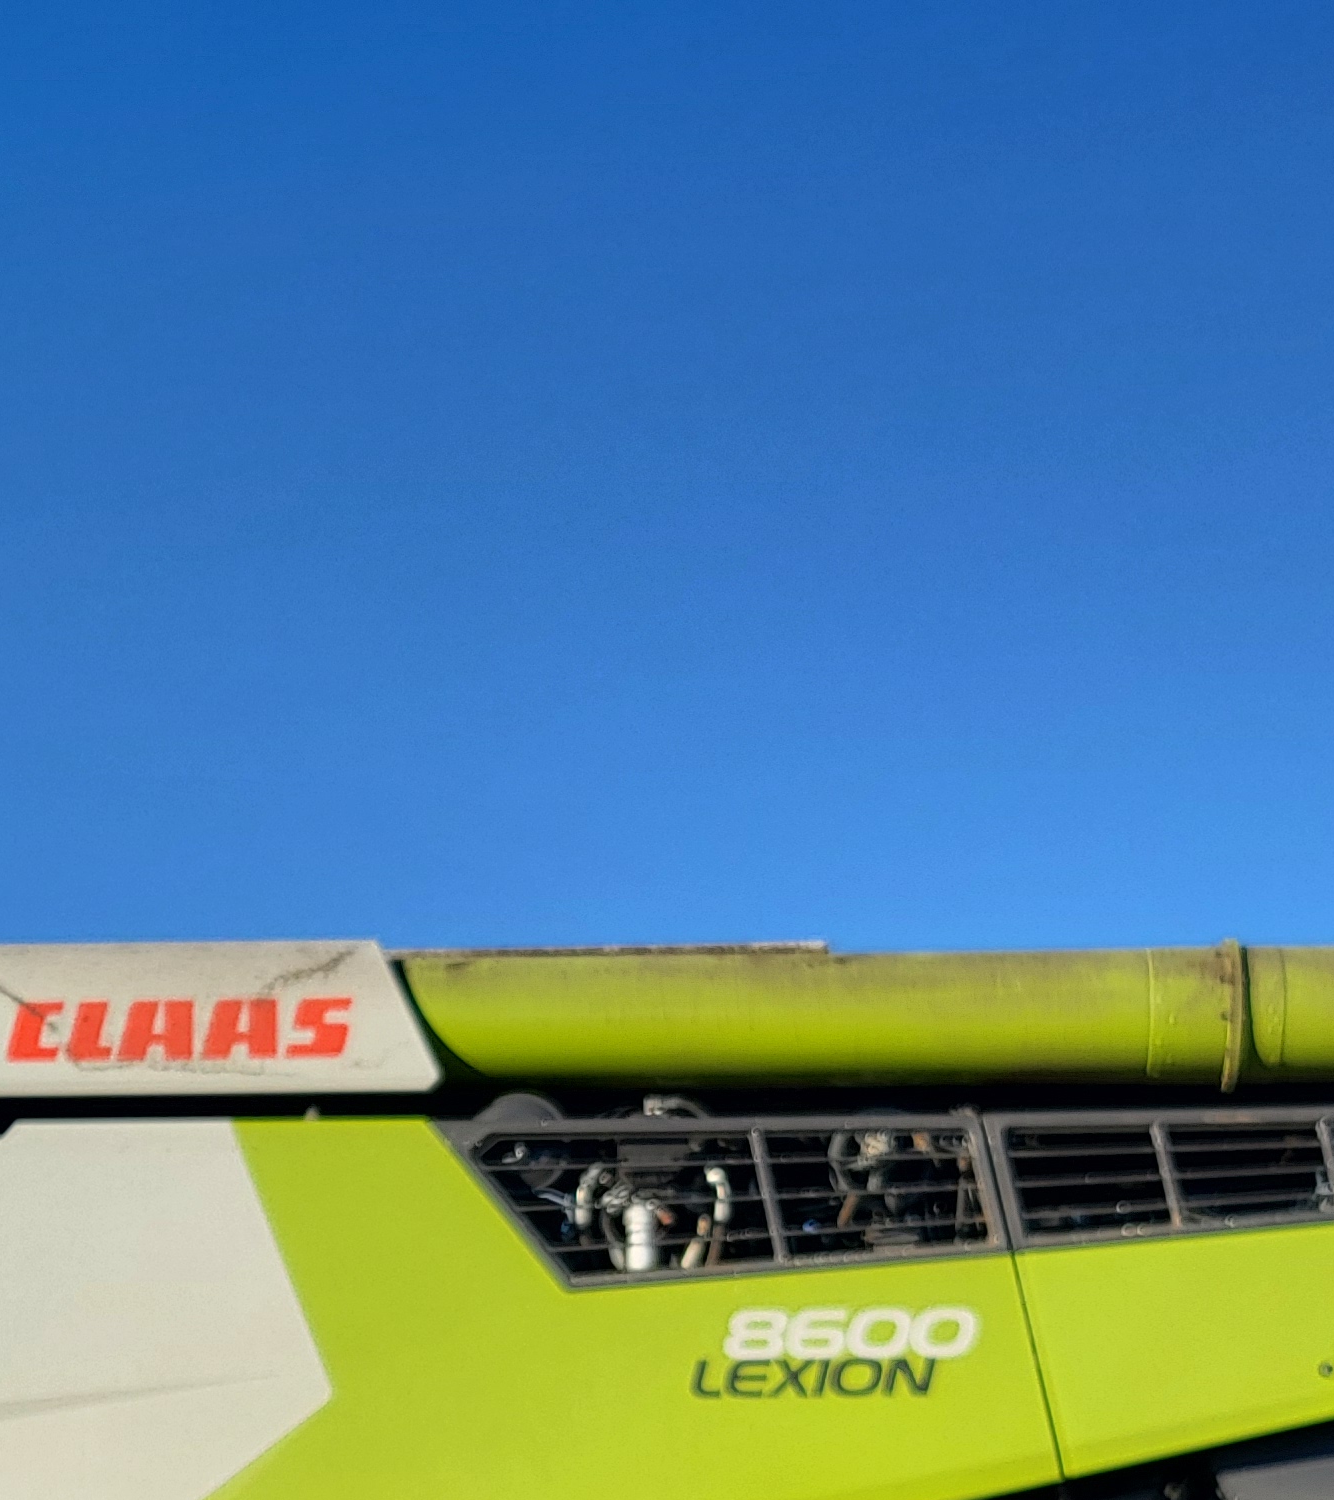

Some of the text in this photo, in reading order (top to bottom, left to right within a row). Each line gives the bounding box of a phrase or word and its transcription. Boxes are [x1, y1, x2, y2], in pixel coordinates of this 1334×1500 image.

[6, 997, 353, 1063] CLAAS
[723, 1306, 978, 1360] 8600
[689, 1357, 935, 1398] LEXION
